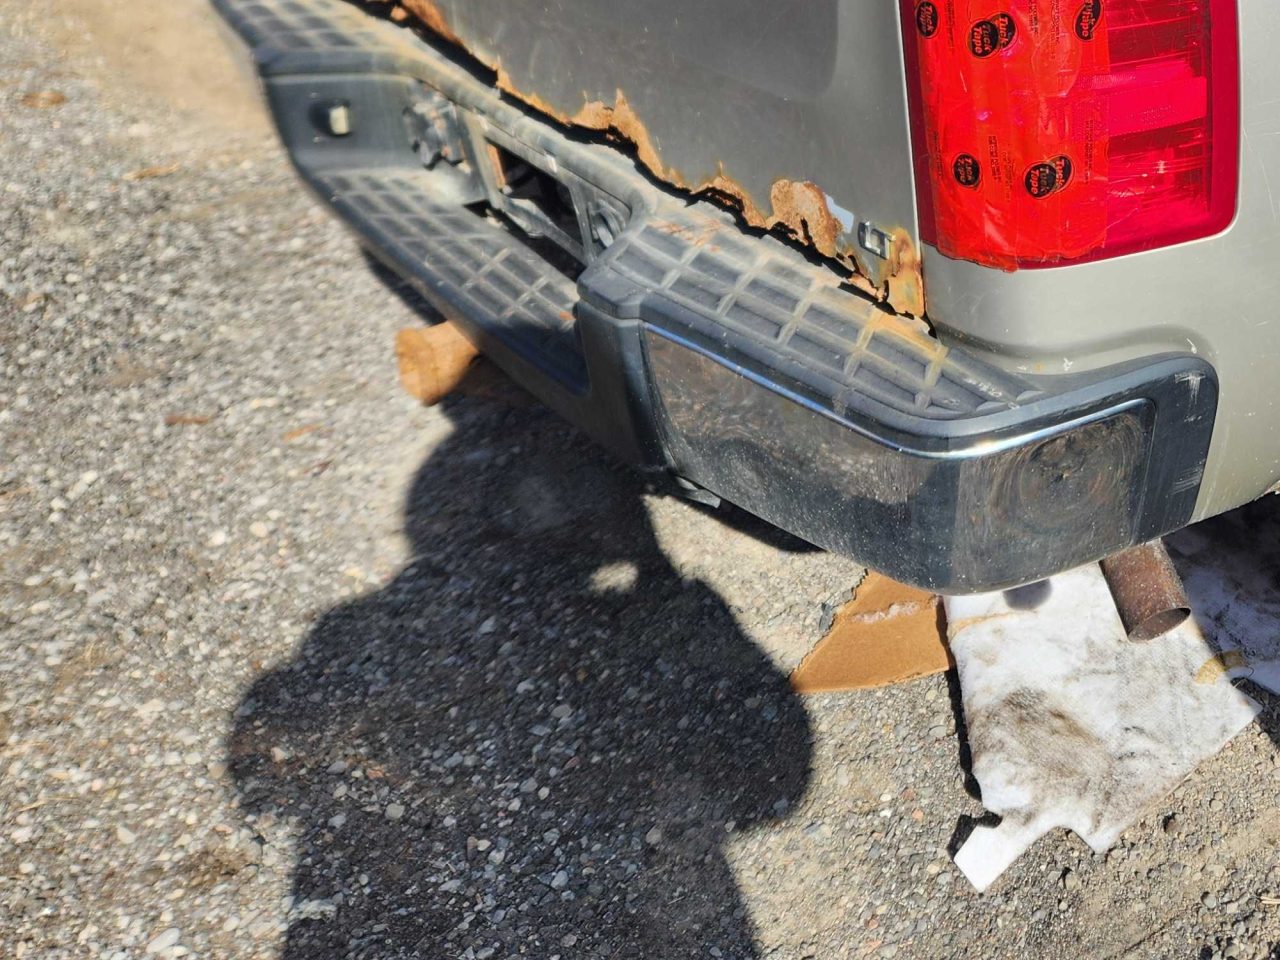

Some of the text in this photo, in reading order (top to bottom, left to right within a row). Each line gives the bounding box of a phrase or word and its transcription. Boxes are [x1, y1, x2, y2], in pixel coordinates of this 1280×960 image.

[982, 23, 992, 52] Tuck
[999, 16, 1010, 49] Tuck
[1080, 9, 1091, 38] Tape
[972, 26, 983, 54] Tape
[1030, 169, 1041, 195] Tape
[1055, 158, 1066, 188] Tuck
